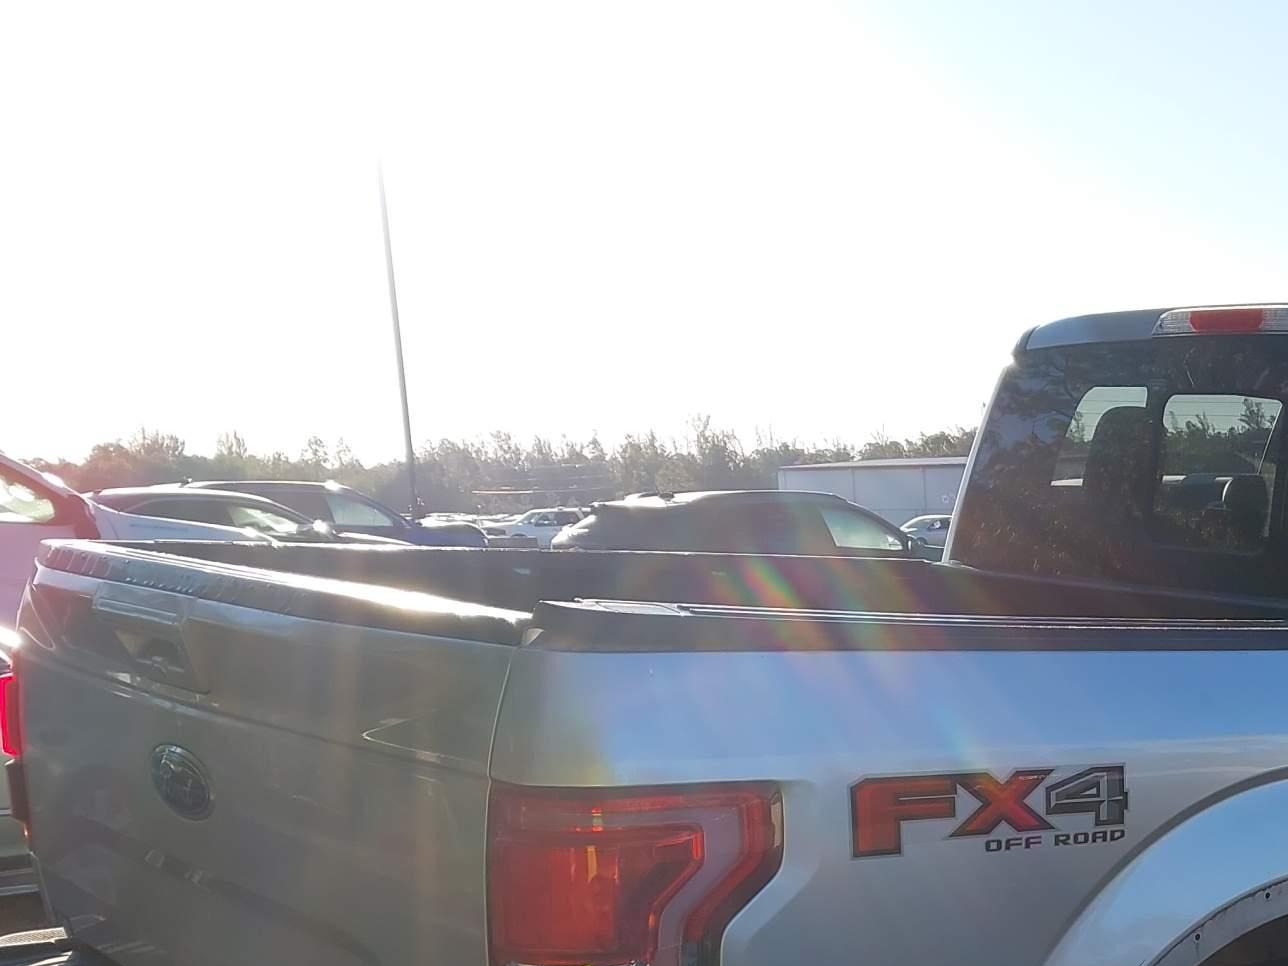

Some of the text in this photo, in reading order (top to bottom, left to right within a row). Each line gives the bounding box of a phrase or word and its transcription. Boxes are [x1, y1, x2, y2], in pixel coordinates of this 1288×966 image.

[850, 765, 1128, 858] FX4
[985, 829, 1126, 852] OFF ROAD
